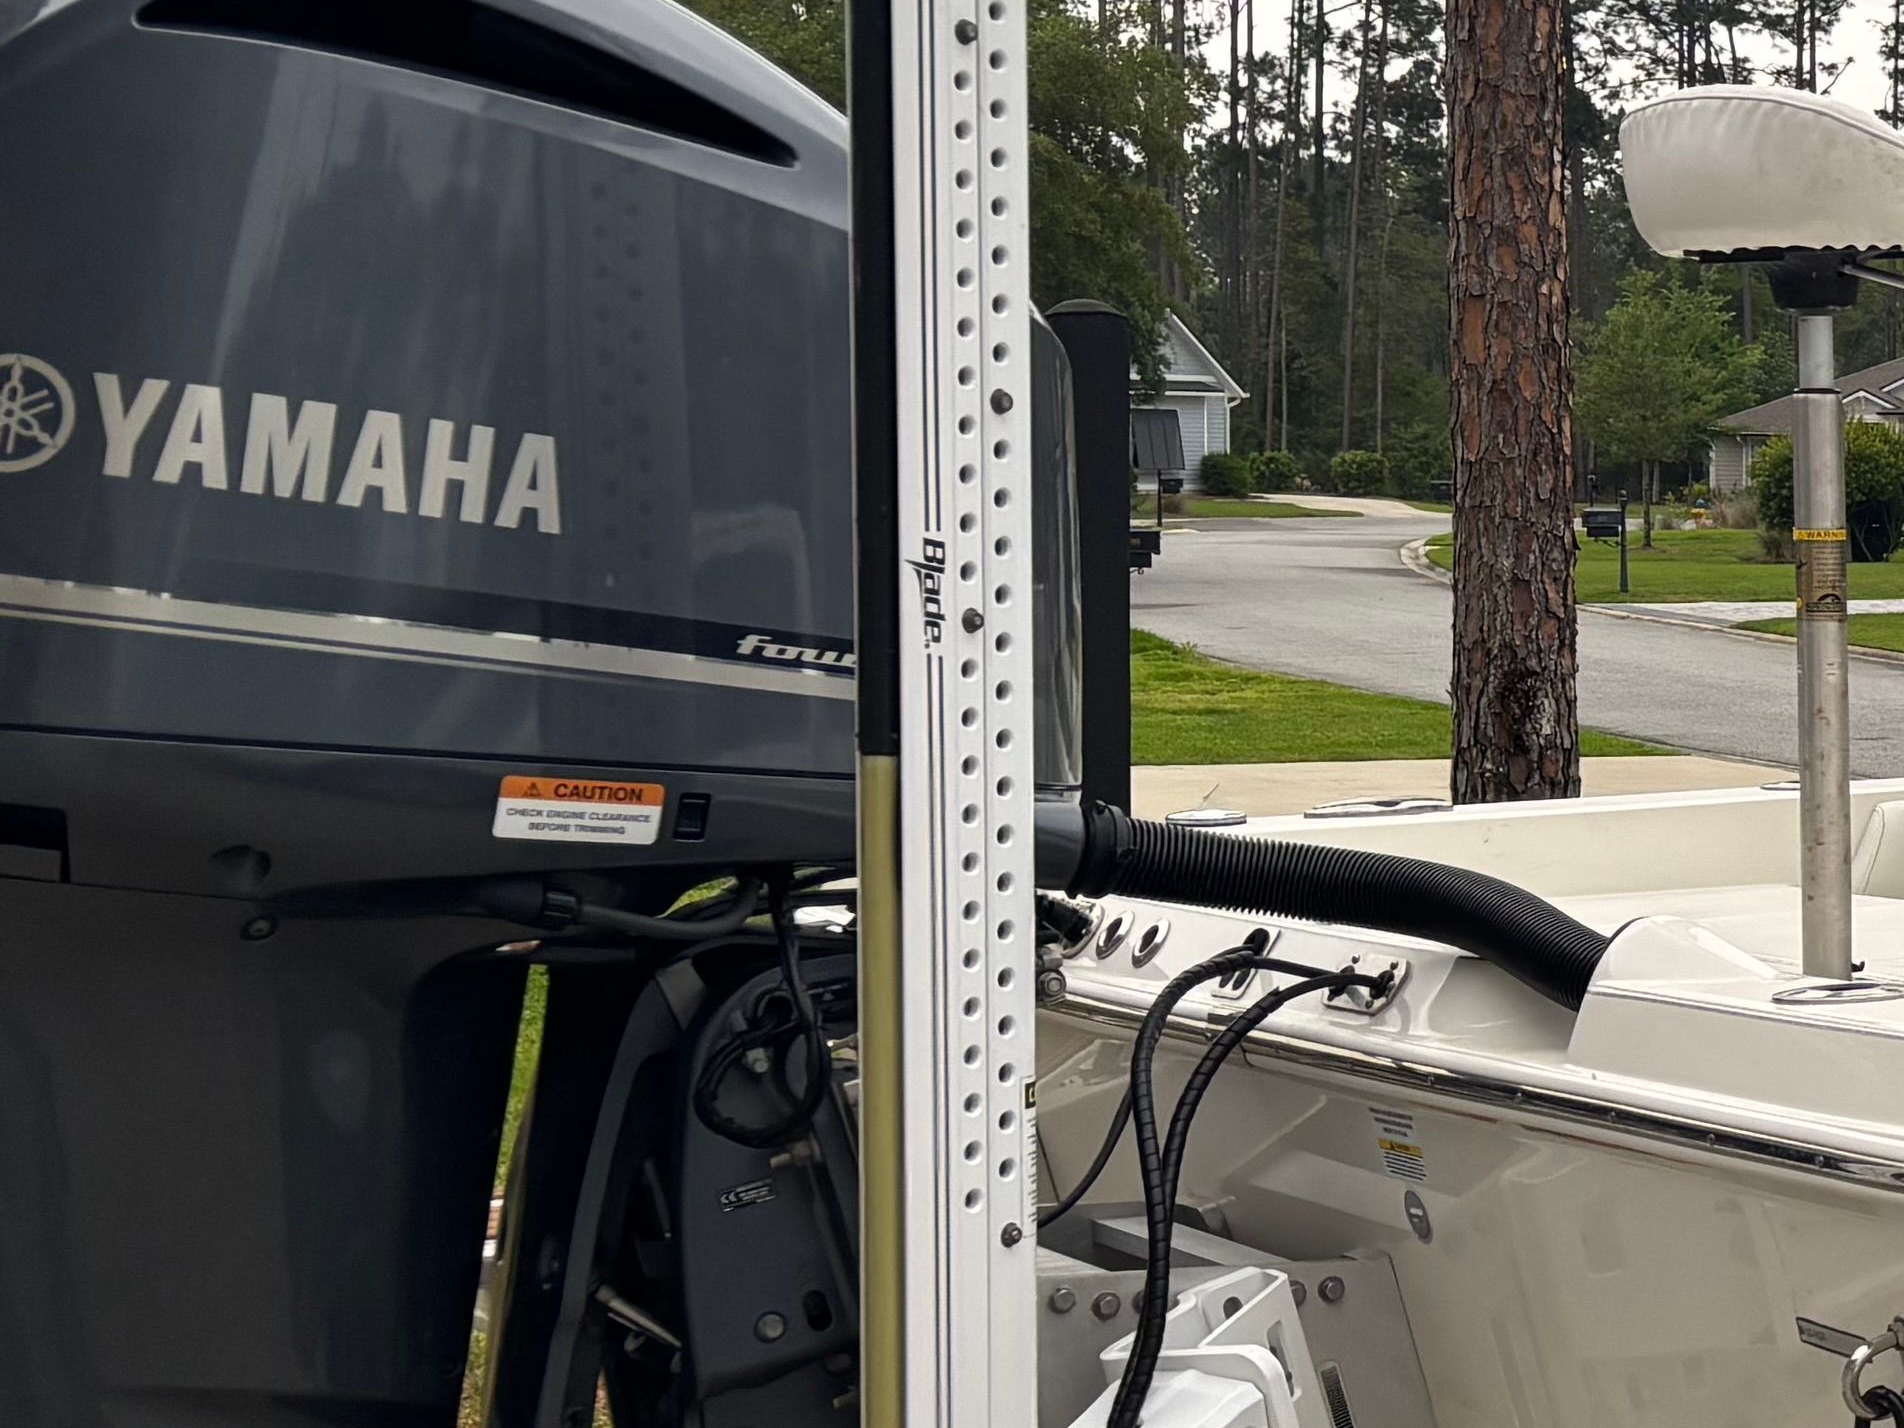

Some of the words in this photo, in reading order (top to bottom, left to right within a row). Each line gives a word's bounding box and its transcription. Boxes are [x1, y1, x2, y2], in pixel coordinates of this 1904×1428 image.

[93, 372, 562, 535] YAMAHA
[904, 537, 946, 645] Blade
[553, 783, 644, 802] CAUTION
[506, 807, 544, 818] CHECK
[546, 809, 587, 820] ENGINE
[588, 811, 652, 823] CLEARANCE
[528, 822, 570, 833] BEFORE
